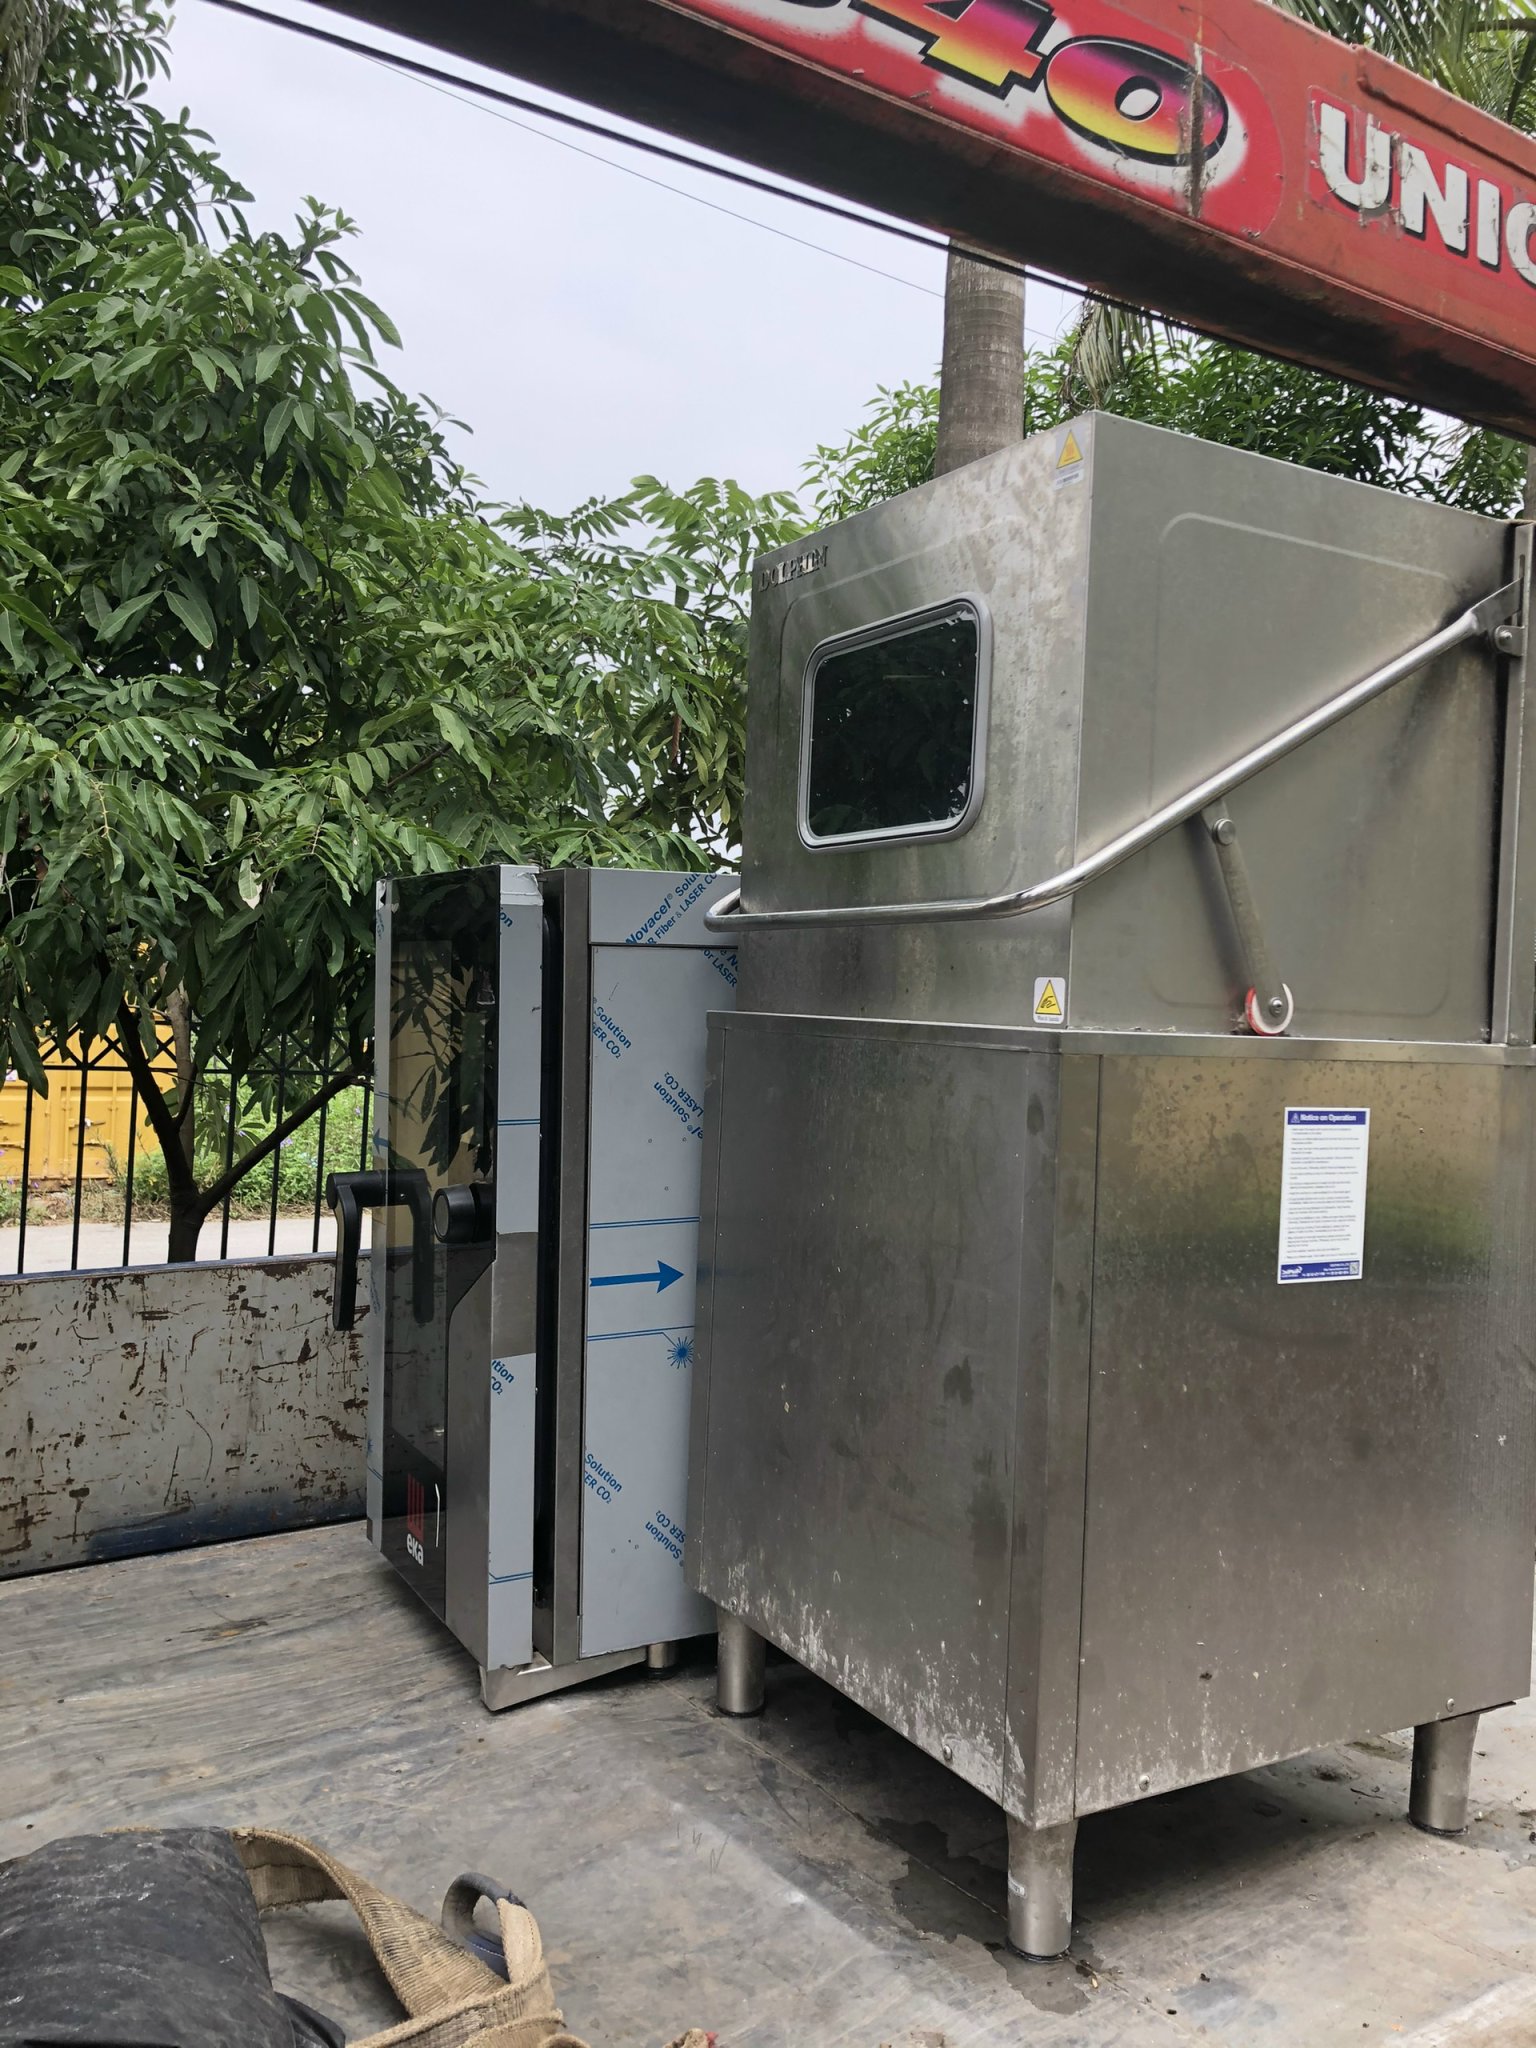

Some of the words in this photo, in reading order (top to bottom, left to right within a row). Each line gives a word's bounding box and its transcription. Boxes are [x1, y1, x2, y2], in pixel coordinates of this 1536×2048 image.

[758, 545, 828, 592] DOLPHIN
[654, 915, 676, 939] Fiber
[680, 883, 706, 912] LASER
[712, 957, 738, 988] LASER
[595, 1006, 631, 1049] Solution
[653, 1081, 690, 1123] Solution
[678, 1088, 704, 1117] LASER
[1328, 1114, 1356, 1122] Operation
[585, 1453, 622, 1492] Solution
[645, 1521, 682, 1560] Solution
